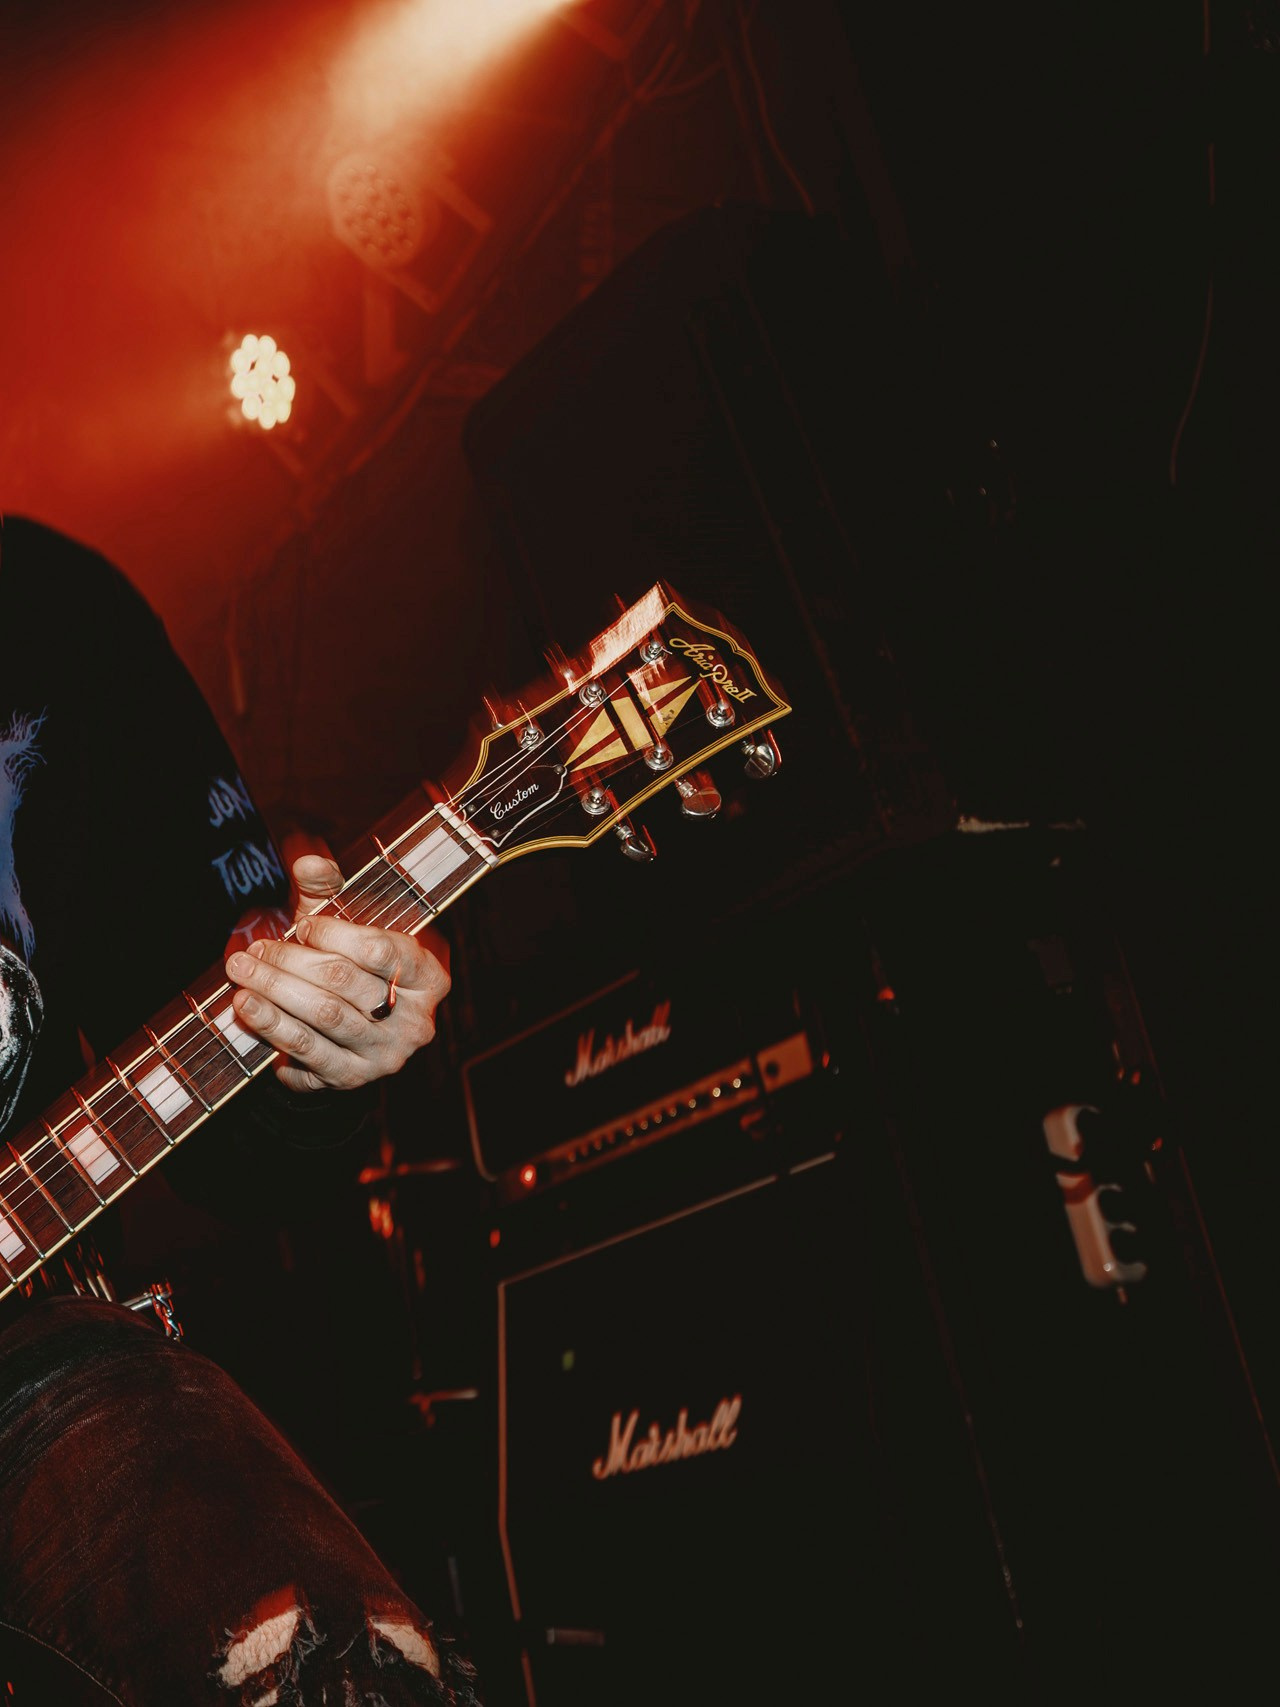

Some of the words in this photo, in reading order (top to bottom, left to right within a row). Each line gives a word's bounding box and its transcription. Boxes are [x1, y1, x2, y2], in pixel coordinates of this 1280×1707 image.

[669, 638, 715, 670] Aria
[699, 664, 739, 695] Pro
[490, 783, 539, 820] Custom
[565, 1000, 671, 1087] Marshall
[592, 1394, 742, 1480] Marshall
